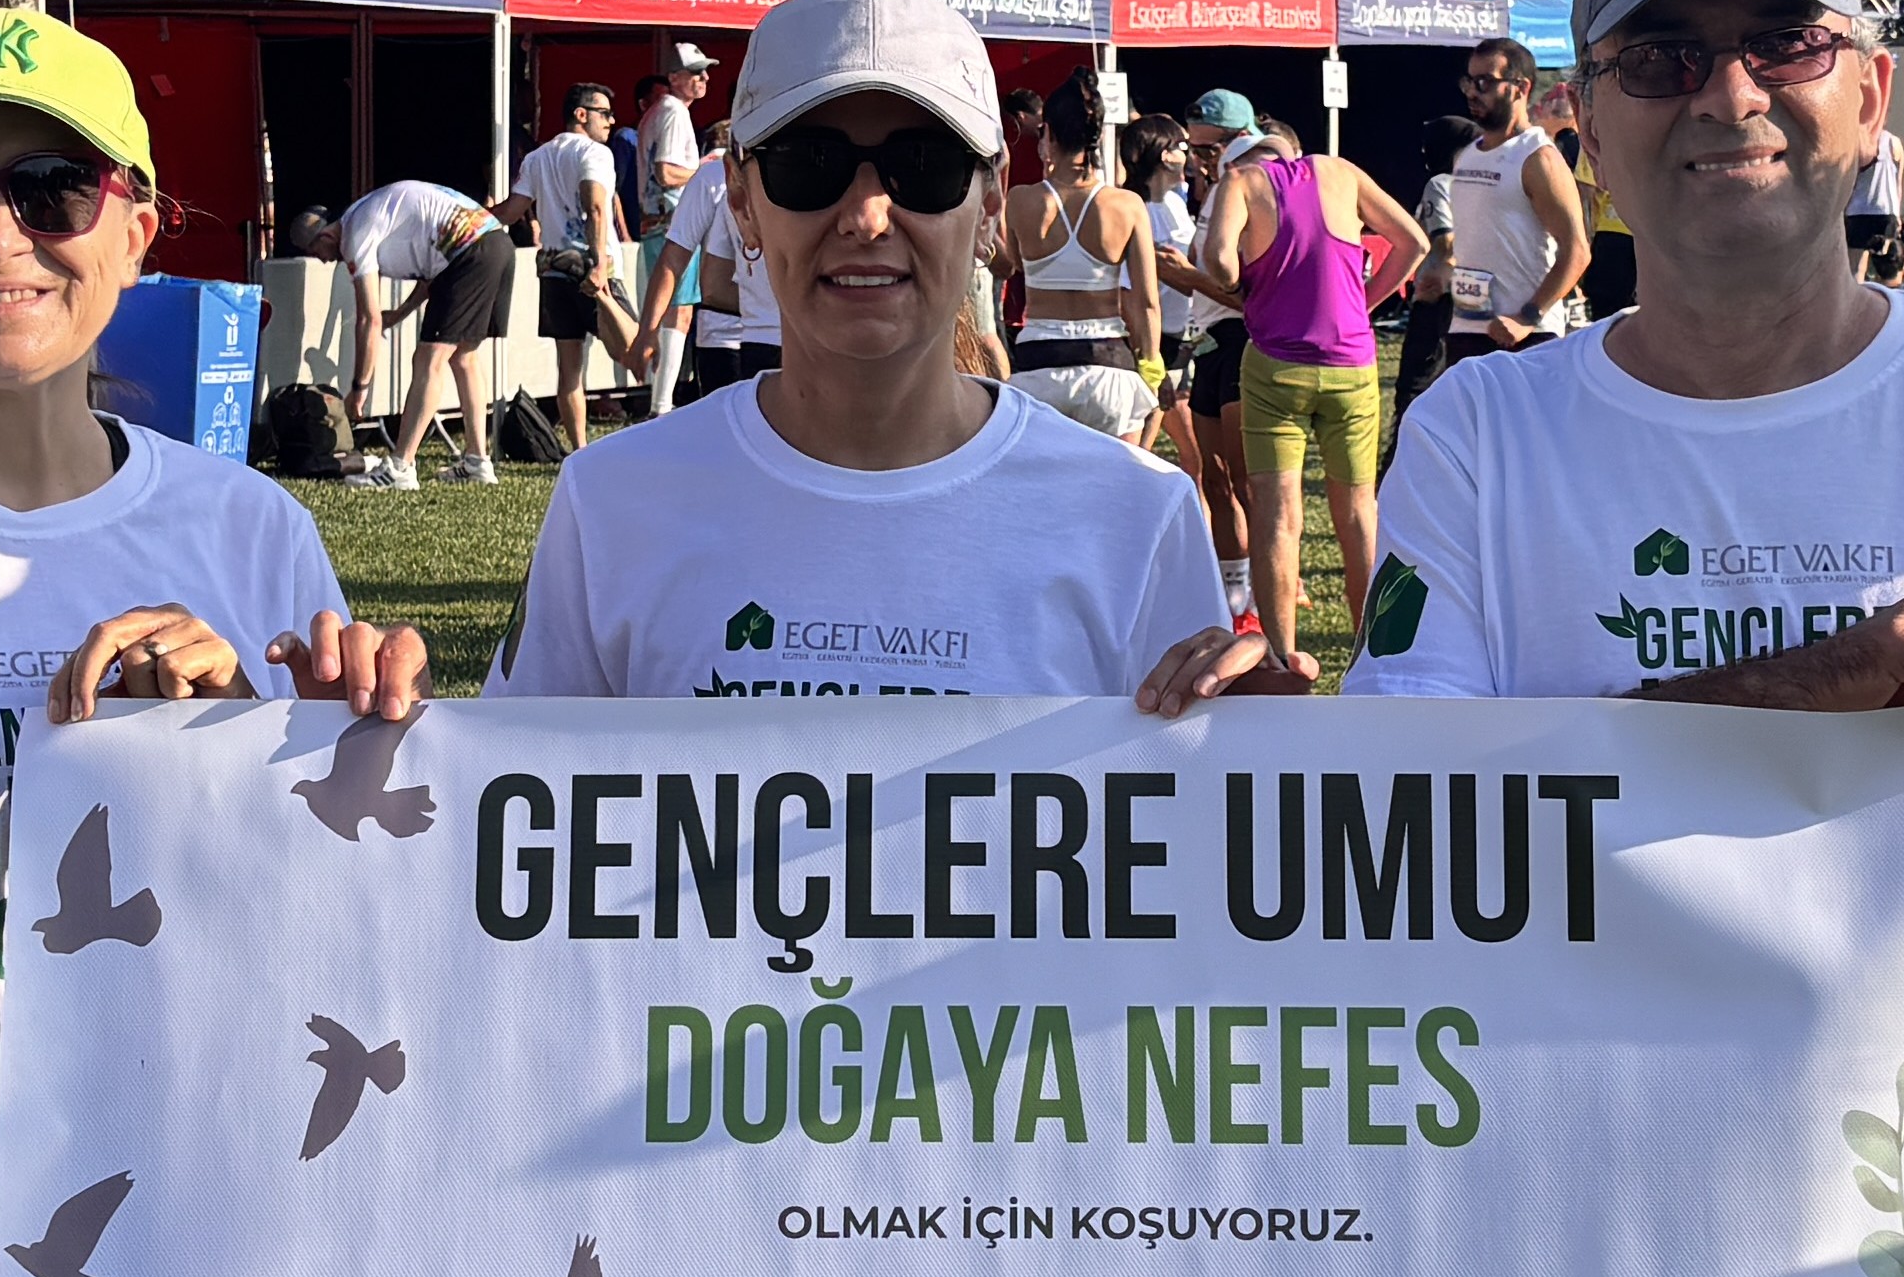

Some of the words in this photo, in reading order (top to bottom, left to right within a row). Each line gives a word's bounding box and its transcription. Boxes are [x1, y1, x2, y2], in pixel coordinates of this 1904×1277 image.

[1701, 545, 1786, 575] EGET
[1793, 543, 1894, 573] VAKFI
[784, 622, 868, 651] EGET
[875, 626, 968, 659] VAKFI
[475, 772, 1175, 973] GENÇLERE
[1225, 772, 1620, 943] UMUT
[645, 976, 1089, 1145] DOĞAYA
[1127, 1005, 1482, 1147] NEFES
[778, 1205, 948, 1241] OLMAK
[962, 1196, 1053, 1249] İÇİN
[1071, 1206, 1374, 1249] KOŞUYORUZ.
